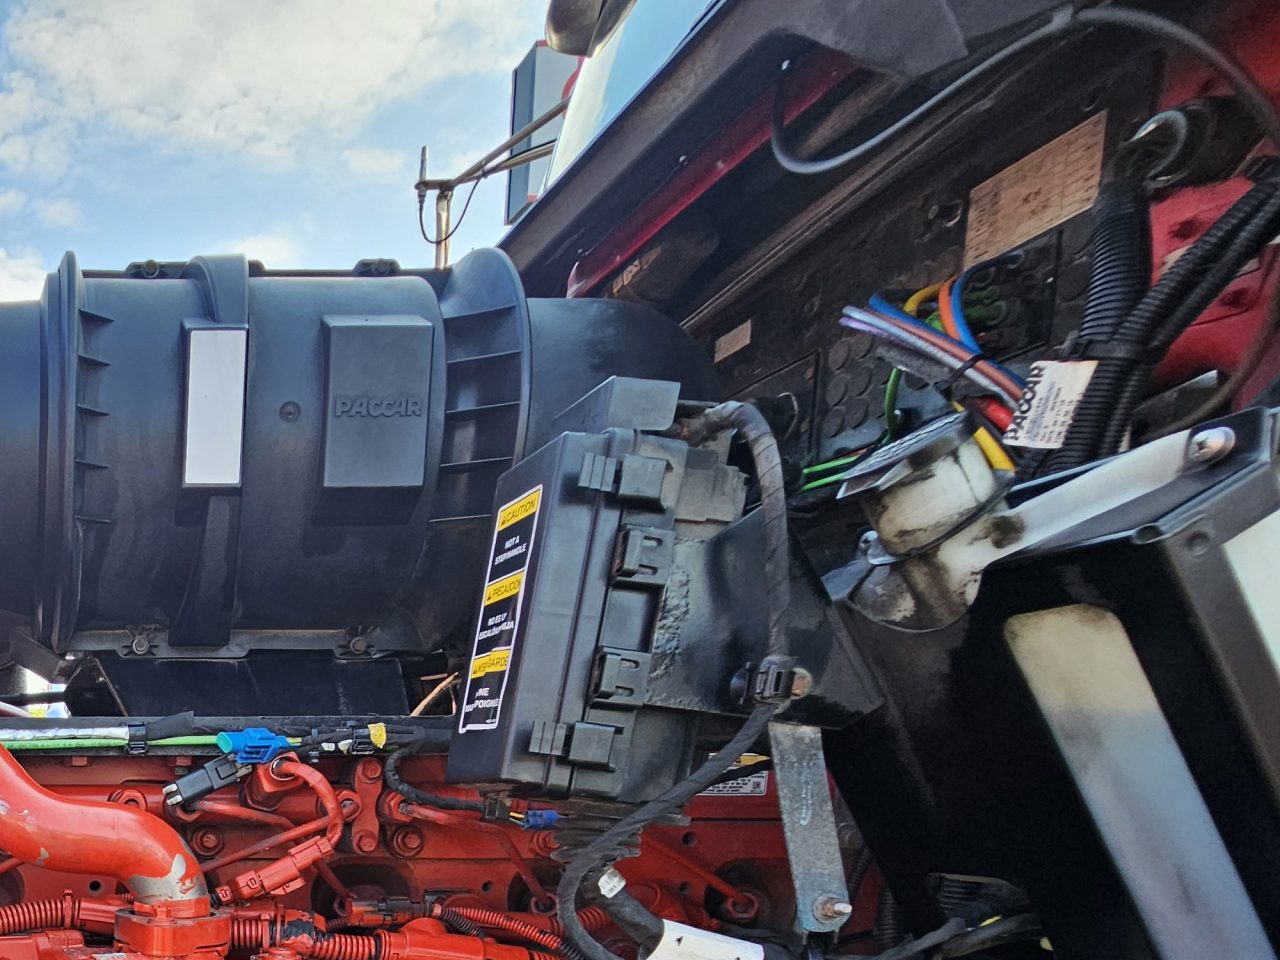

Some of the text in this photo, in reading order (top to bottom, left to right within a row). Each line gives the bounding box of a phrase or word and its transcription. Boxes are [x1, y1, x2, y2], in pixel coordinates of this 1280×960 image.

[334, 396, 422, 418] PACCAR
[1003, 365, 1046, 441] PACCAR
[506, 498, 536, 522] CAUTION
